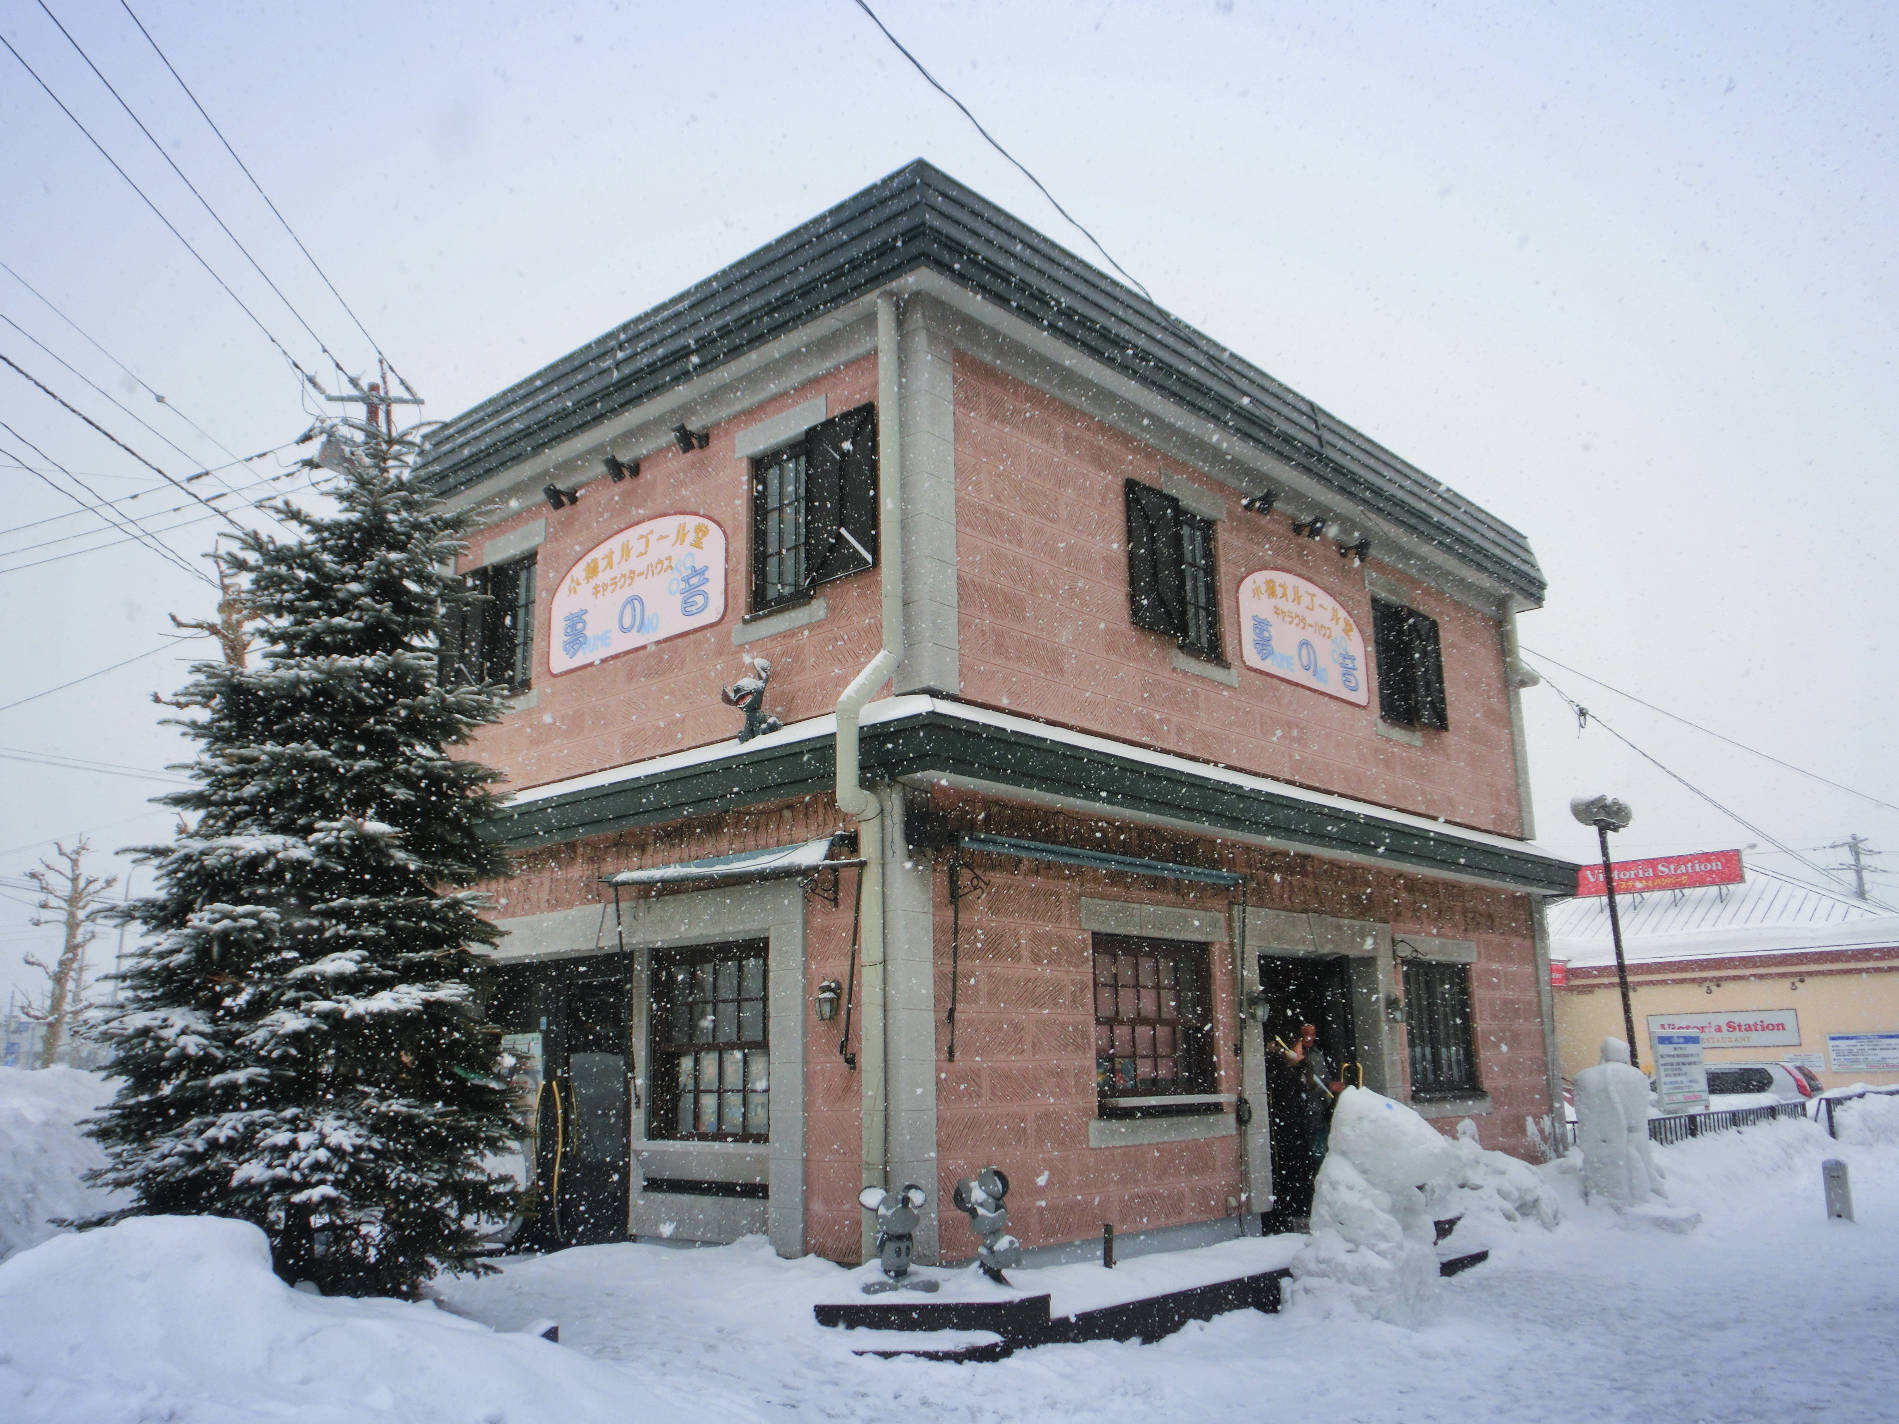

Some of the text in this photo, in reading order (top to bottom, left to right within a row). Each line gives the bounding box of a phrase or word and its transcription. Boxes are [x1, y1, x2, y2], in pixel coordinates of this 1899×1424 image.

[592, 555, 674, 599] キャラクターハウス
[1586, 860, 1723, 883] Vitoria Station
[1619, 874, 1688, 889] ステキ&ハンバーグ
[1726, 1019, 1787, 1033] Station
